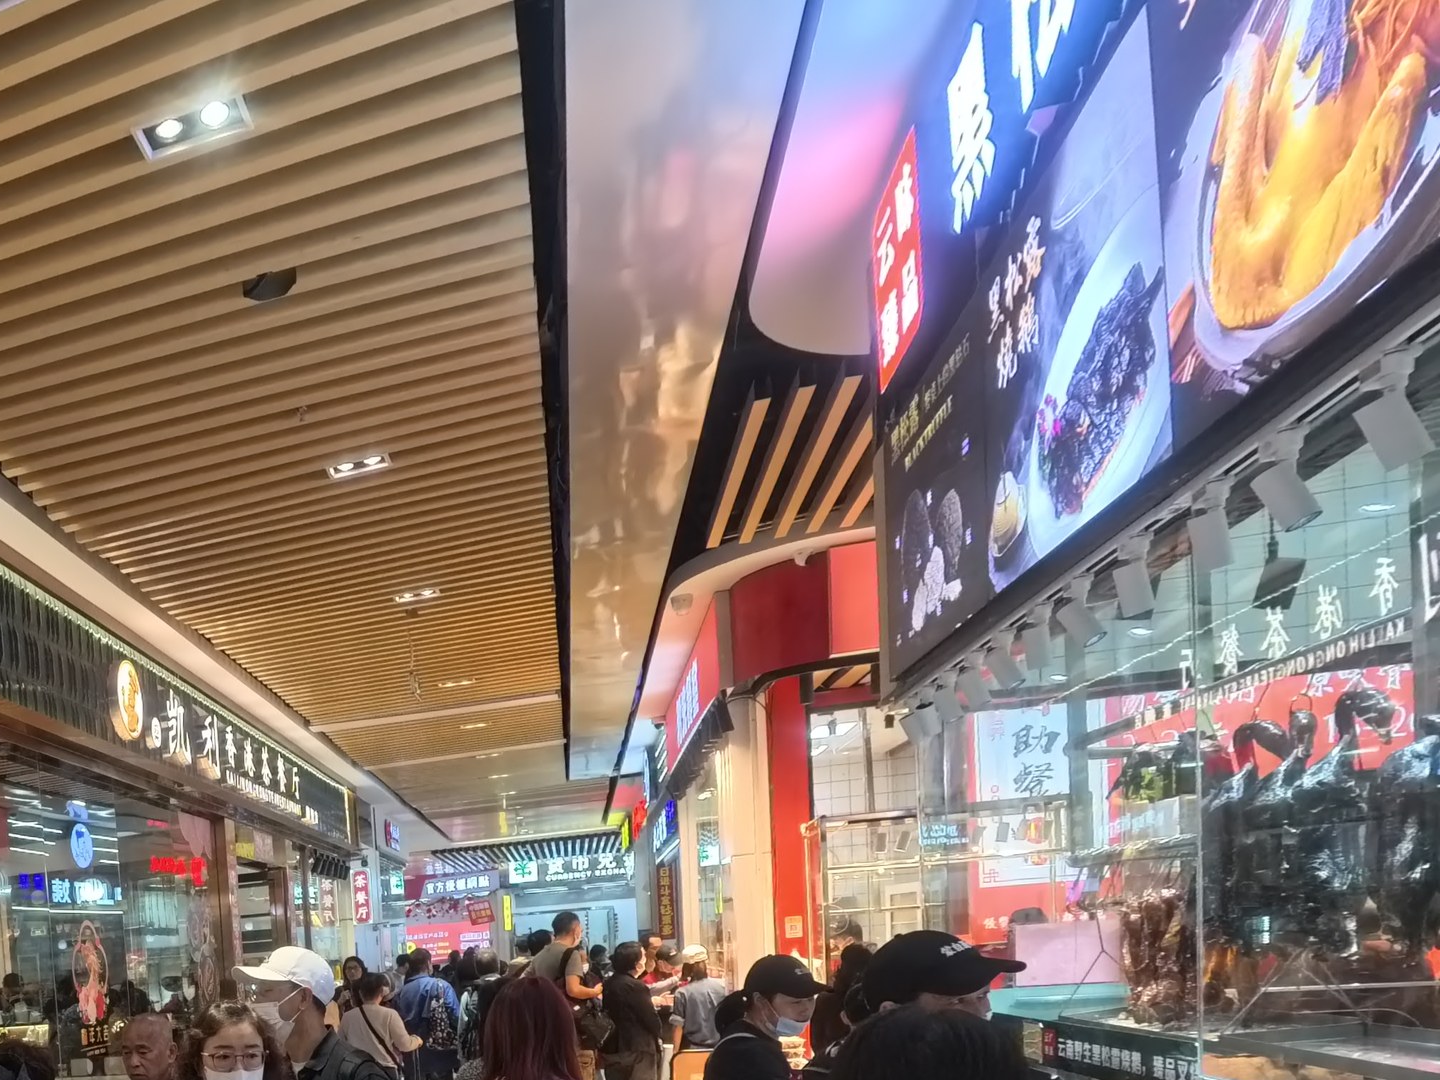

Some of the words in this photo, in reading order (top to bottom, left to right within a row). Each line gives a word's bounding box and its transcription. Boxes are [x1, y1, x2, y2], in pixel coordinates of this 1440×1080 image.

[988, 215, 1046, 343] 黑松露
[166, 689, 301, 800] 凯利香港茶餐厅
[354, 874, 369, 919] 茶餐厅
